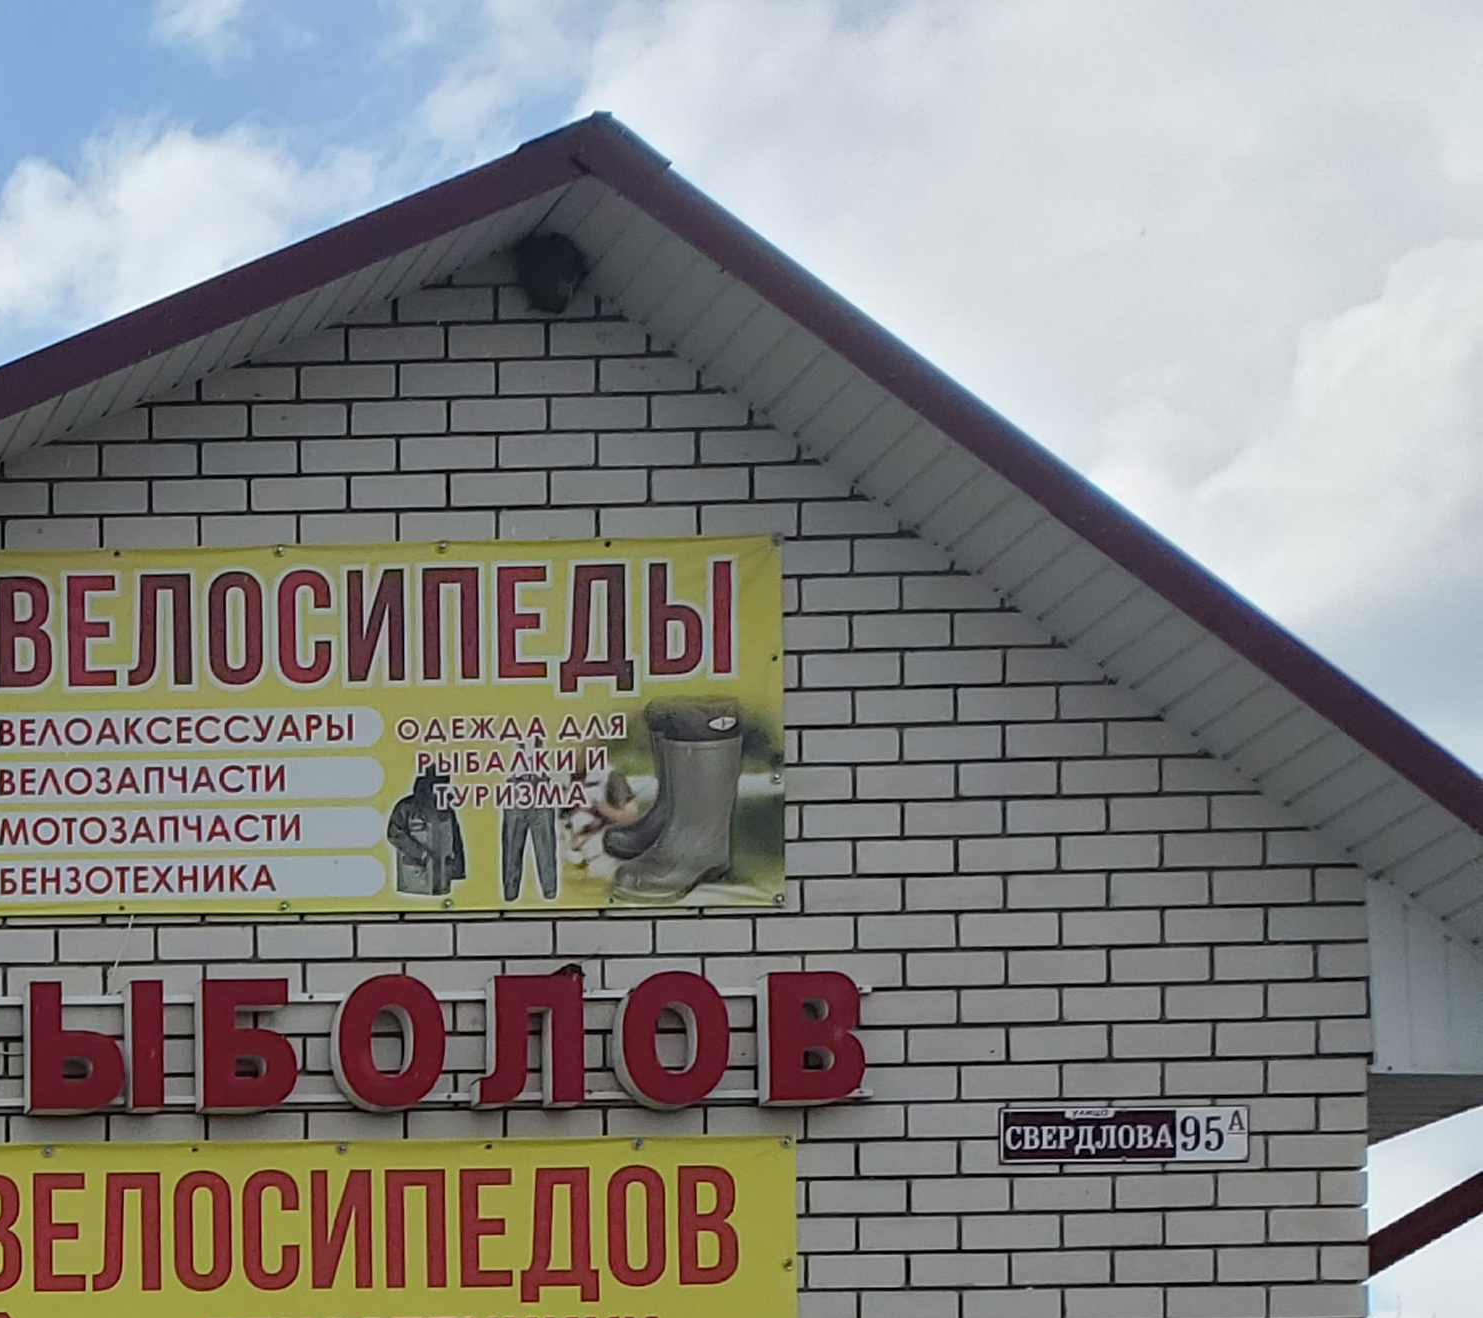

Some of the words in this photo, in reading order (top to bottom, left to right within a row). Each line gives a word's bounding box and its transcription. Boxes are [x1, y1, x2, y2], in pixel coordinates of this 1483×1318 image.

[396, 716, 547, 743] ОДЕЖДА
[558, 714, 627, 741] ДЛЯ
[417, 750, 574, 774] РЫБАЛКИ
[587, 748, 607, 771] И
[434, 784, 588, 808] ТУРИЗМА
[0, 814, 302, 845] МОТОЗАПЧАСТИ
[0, 864, 277, 896] БЕНЗОТЕХНИКА
[1005, 1122, 1175, 1155] СВЕРДЛОВА
